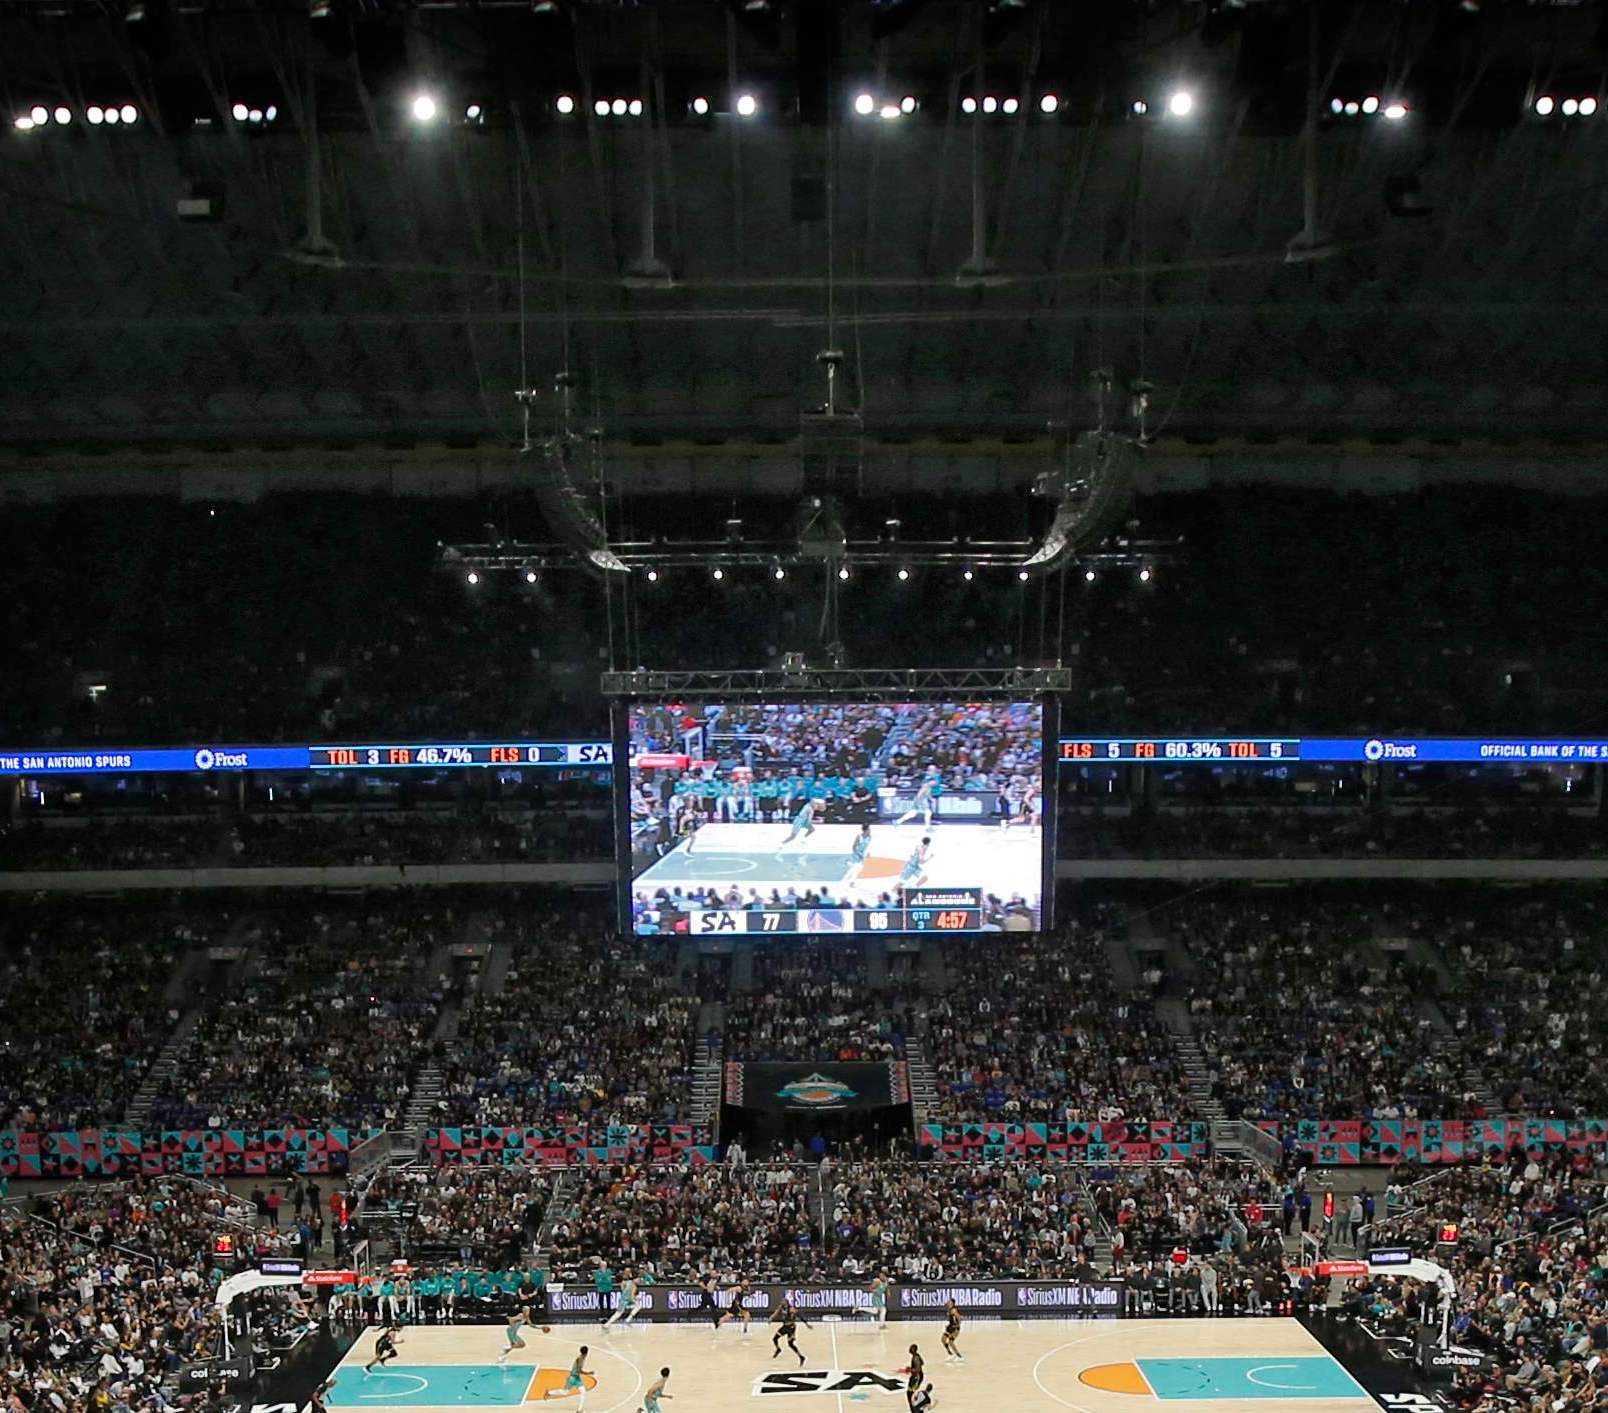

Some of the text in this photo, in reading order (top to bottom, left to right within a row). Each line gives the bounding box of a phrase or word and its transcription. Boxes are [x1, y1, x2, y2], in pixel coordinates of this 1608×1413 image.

[328, 746, 610, 765] TOL 3 FG 46.7% FLS 0 SA
[1064, 742, 1282, 758] FLS 5 FG 60.3% TOL 5
[1383, 744, 1417, 758] Frost
[1481, 744, 1527, 757] OFFICIAL
[1530, 745, 1558, 757] BANK
[1561, 745, 1574, 757] OF
[1578, 745, 1598, 757] THE
[0, 757, 19, 769] THE
[23, 757, 44, 769] SAN
[47, 756, 93, 768] ANTONIO
[96, 755, 131, 767] SPURS
[214, 753, 248, 767] Frost
[701, 913, 888, 932] SA 77 95
[912, 911, 930, 921] QTR
[918, 911, 968, 929] 3 4:57
[794, 1290, 855, 1308] SiriusXM NBA
[911, 1288, 1002, 1307] SiriusXM NBA Radio
[1027, 1287, 1066, 1305] SiriusXM
[1433, 1353, 1481, 1366] coinbase
[191, 1367, 239, 1379] coiase
[754, 1369, 909, 1395] SA
